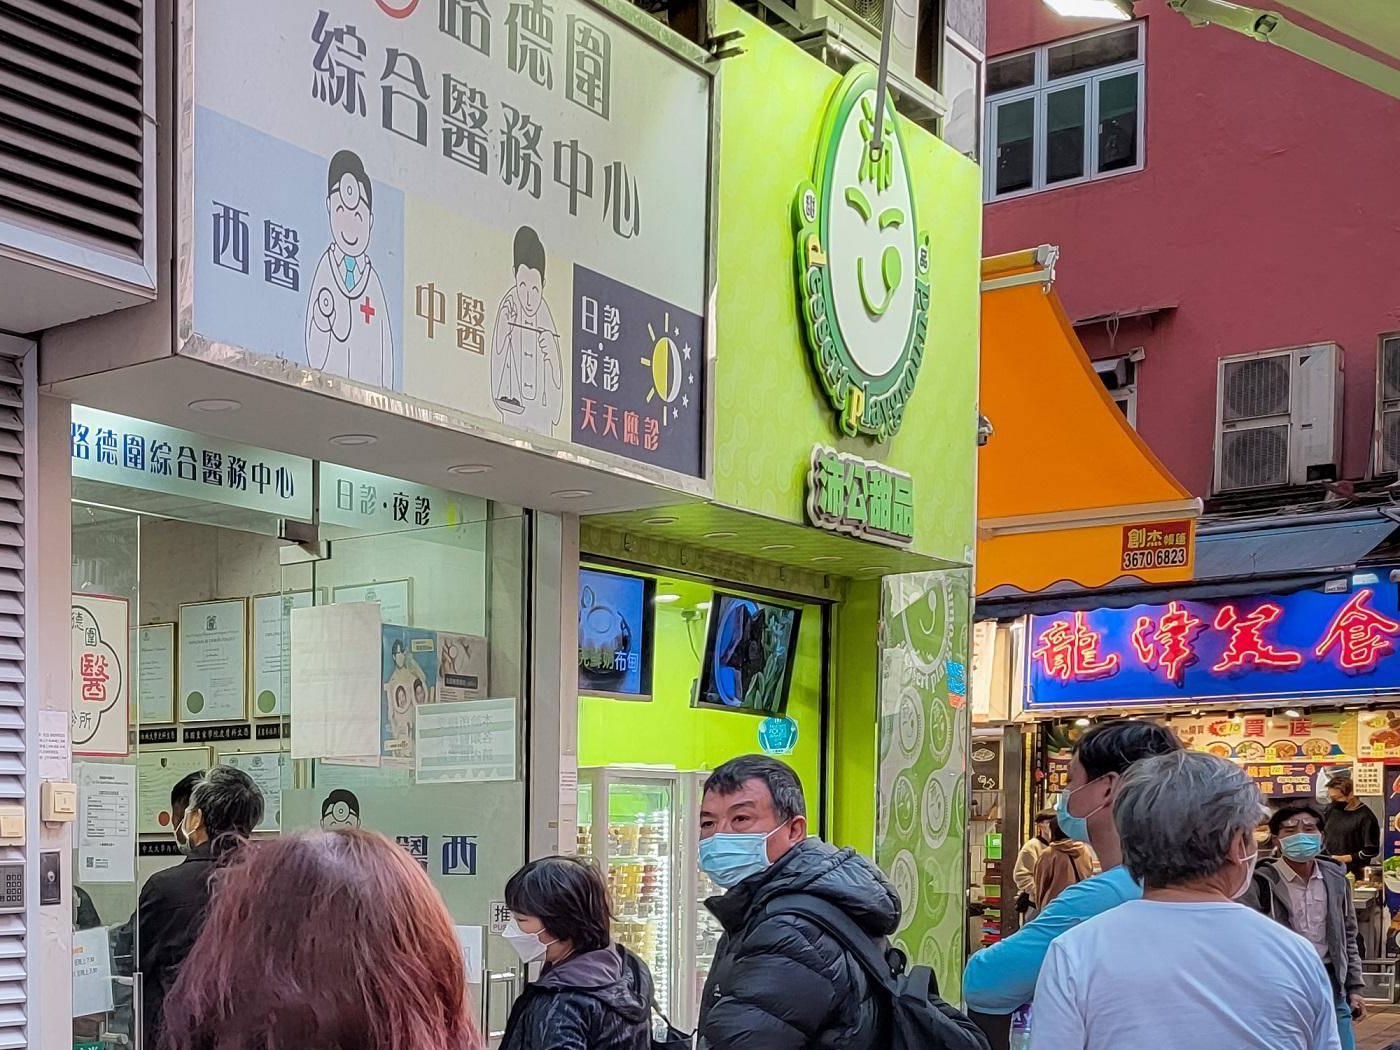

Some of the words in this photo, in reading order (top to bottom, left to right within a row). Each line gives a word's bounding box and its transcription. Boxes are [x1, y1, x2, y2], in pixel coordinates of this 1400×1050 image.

[309, 9, 641, 240] 綜合醫務中心
[211, 200, 300, 292] 西醫
[415, 281, 485, 356] 中醫
[581, 397, 660, 451] 天天應診
[1124, 550, 1153, 569] 3670
[1156, 548, 1186, 567] 6823
